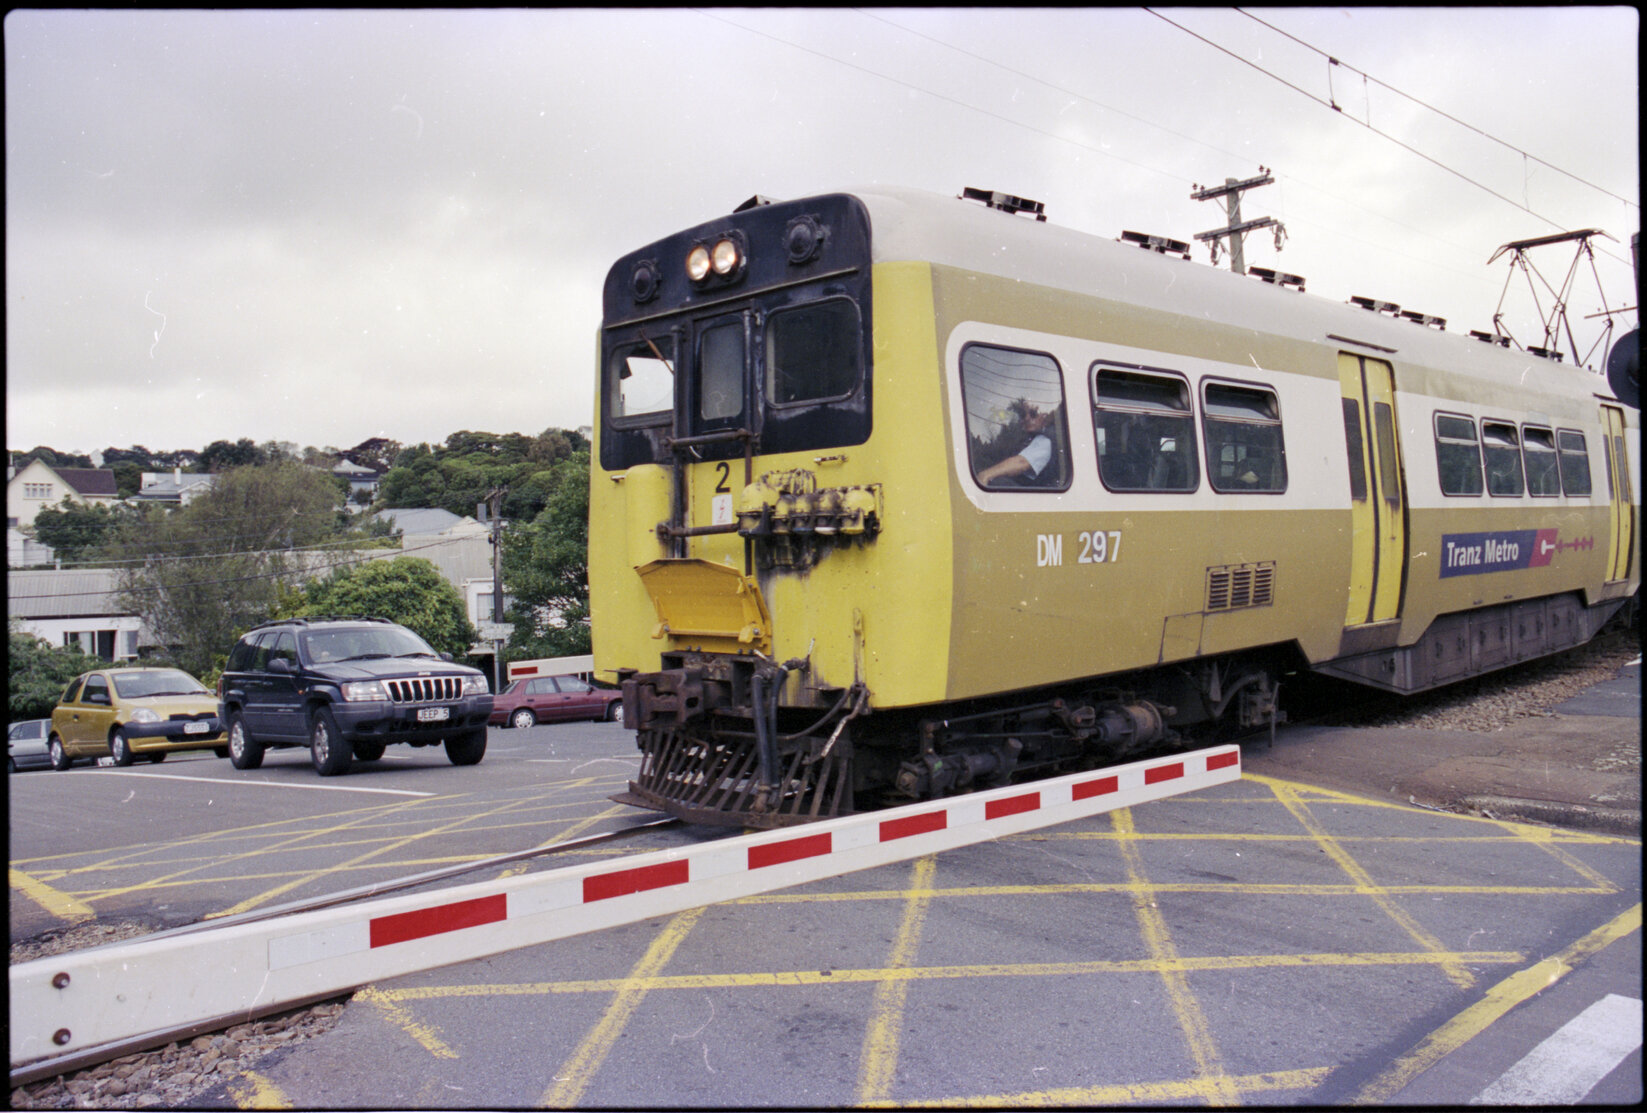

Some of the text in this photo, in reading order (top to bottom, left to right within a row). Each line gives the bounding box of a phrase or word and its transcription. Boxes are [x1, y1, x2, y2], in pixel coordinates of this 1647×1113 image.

[715, 461, 731, 494] 2
[1037, 530, 1122, 567] DM 297
[1447, 539, 1519, 568] Tranz Metro
[418, 709, 439, 719] JEEP
